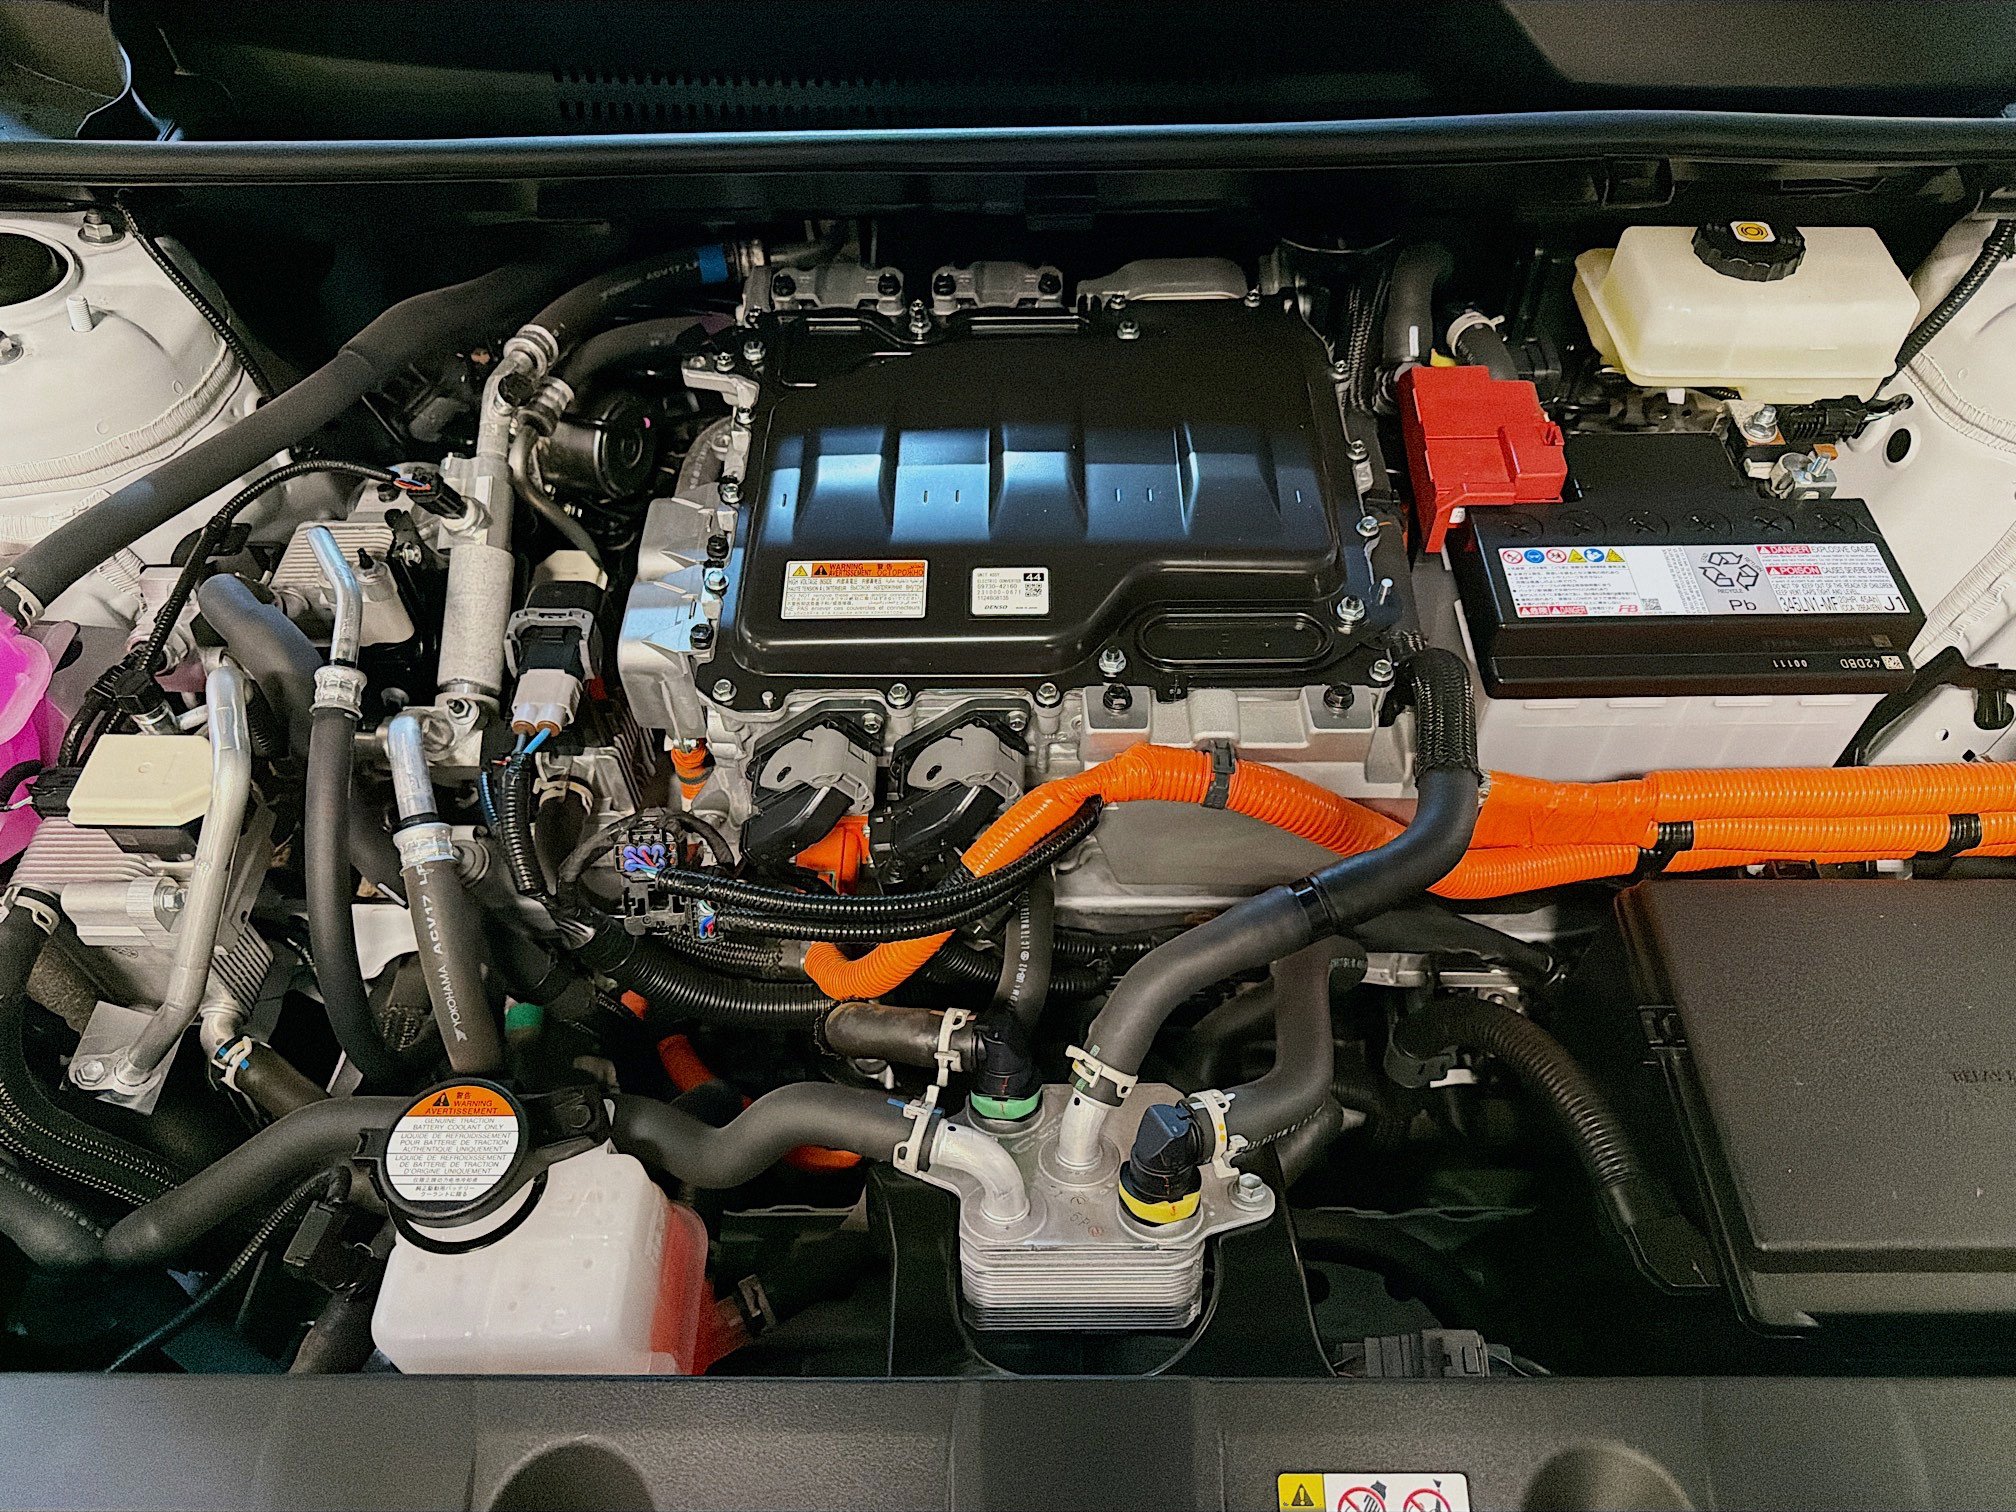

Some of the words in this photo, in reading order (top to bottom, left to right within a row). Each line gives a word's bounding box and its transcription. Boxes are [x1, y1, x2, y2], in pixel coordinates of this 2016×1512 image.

[1781, 566, 1819, 574] POISON
[1867, 566, 1887, 574] BURNS
[1560, 606, 1587, 614] DANGER
[1619, 604, 1639, 613] FB
[1729, 600, 1757, 611] Pb
[1840, 658, 1880, 669] 42DBD
[422, 894, 444, 955] ACV17
[438, 964, 462, 1030] YOKOHAMA
[456, 1092, 472, 1100] 警告
